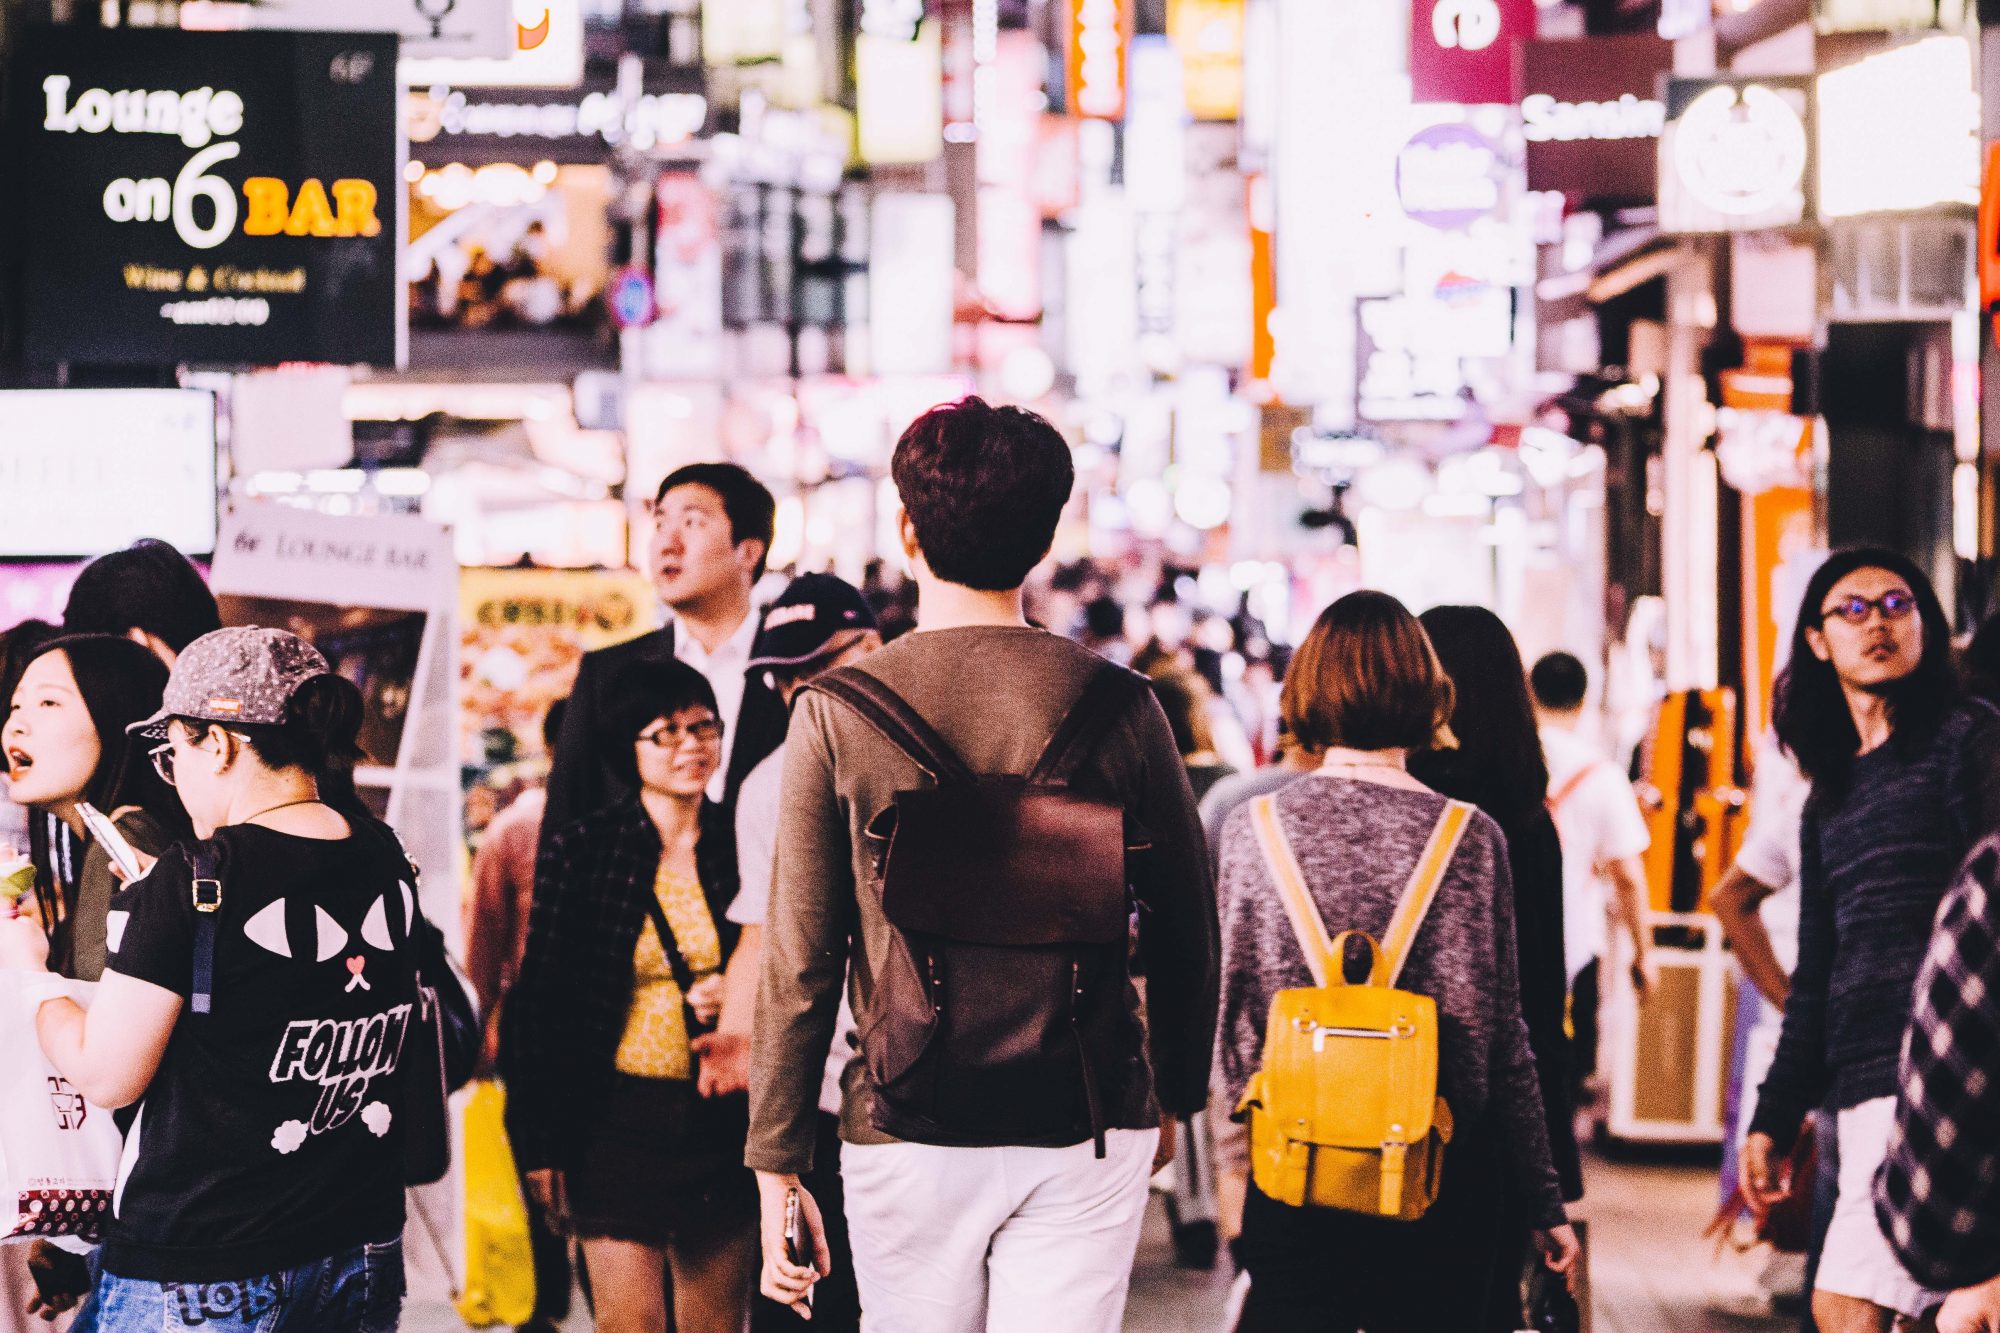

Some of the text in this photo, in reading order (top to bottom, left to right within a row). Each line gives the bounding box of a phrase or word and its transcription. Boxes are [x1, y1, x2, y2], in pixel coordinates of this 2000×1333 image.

[43, 75, 244, 148] Lounge
[243, 177, 381, 237] BAR
[269, 1004, 413, 1083] FOLLOW
[310, 1076, 369, 1135] US
